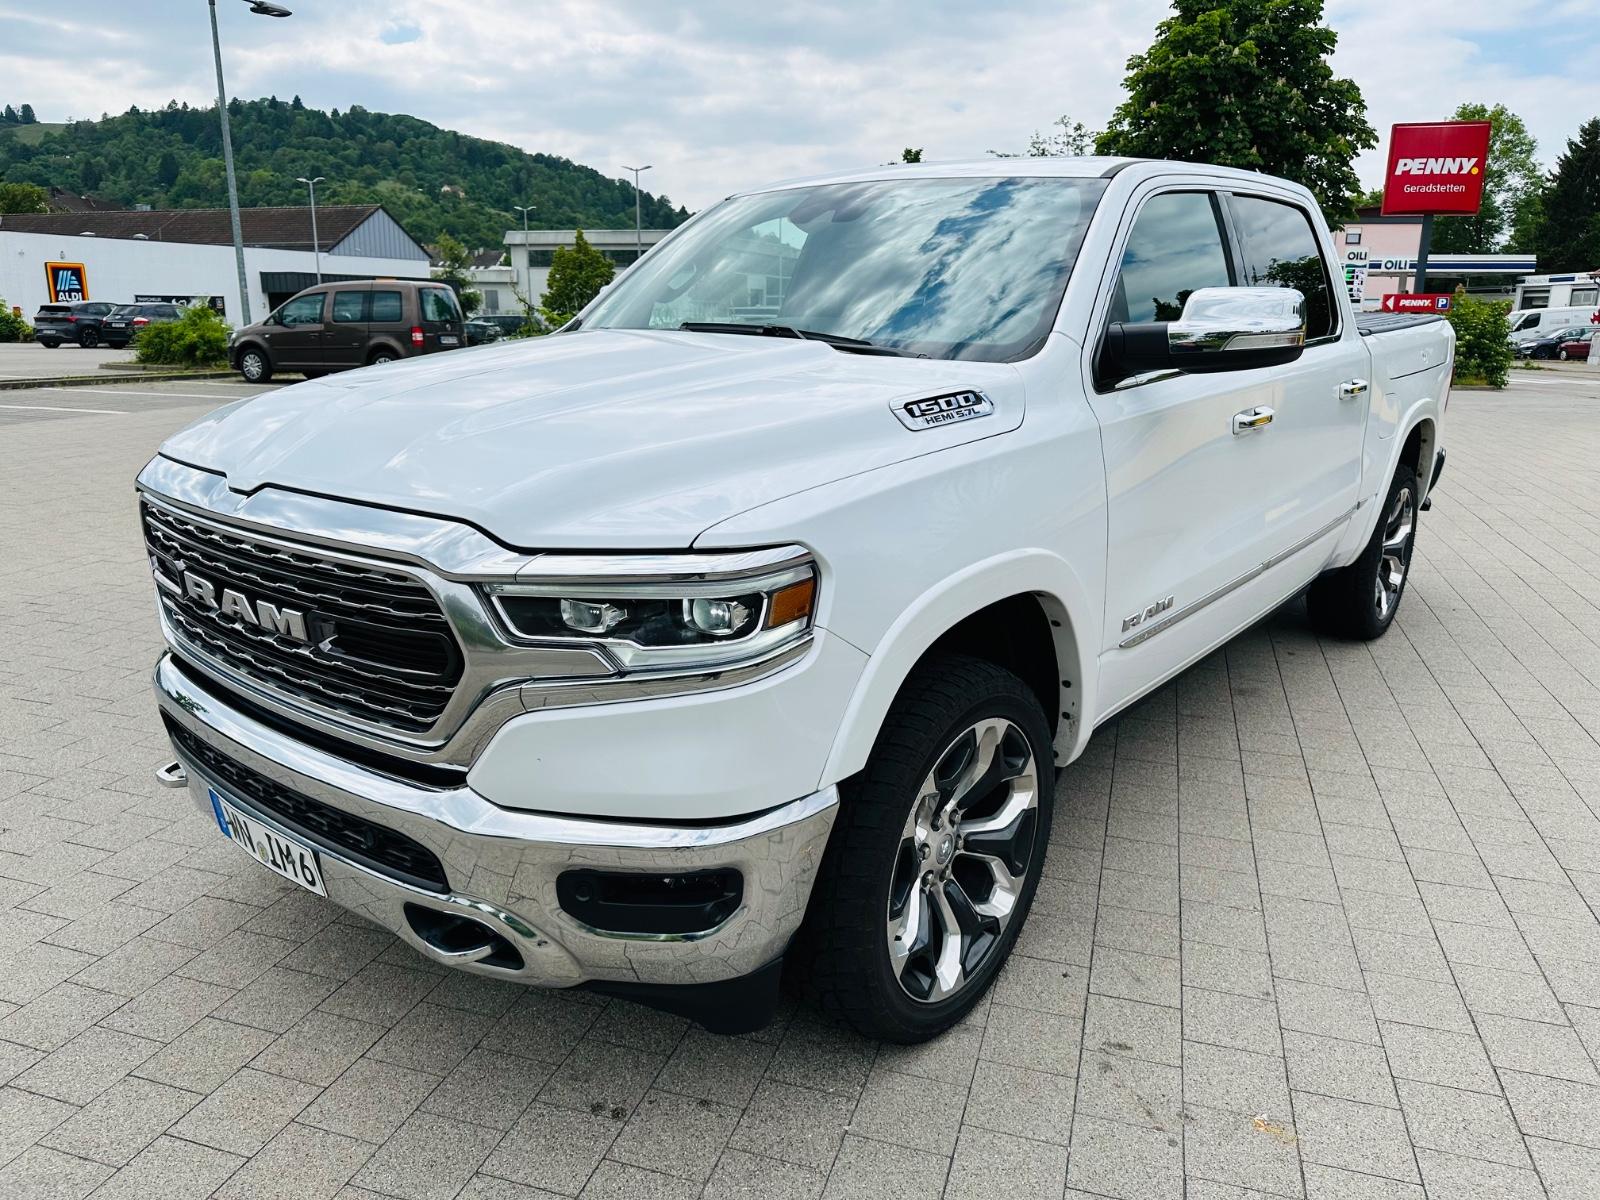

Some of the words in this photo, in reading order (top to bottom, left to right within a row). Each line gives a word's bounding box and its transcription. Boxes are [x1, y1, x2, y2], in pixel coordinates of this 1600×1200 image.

[1404, 184, 1466, 193] Geradstetten
[1384, 260, 1408, 270] OILI
[58, 292, 83, 301] ALDI
[907, 393, 976, 417] 1500
[925, 412, 955, 425] HEMI
[956, 407, 980, 418] 5.7L
[183, 570, 309, 641] RAM
[1121, 594, 1174, 633] RAM
